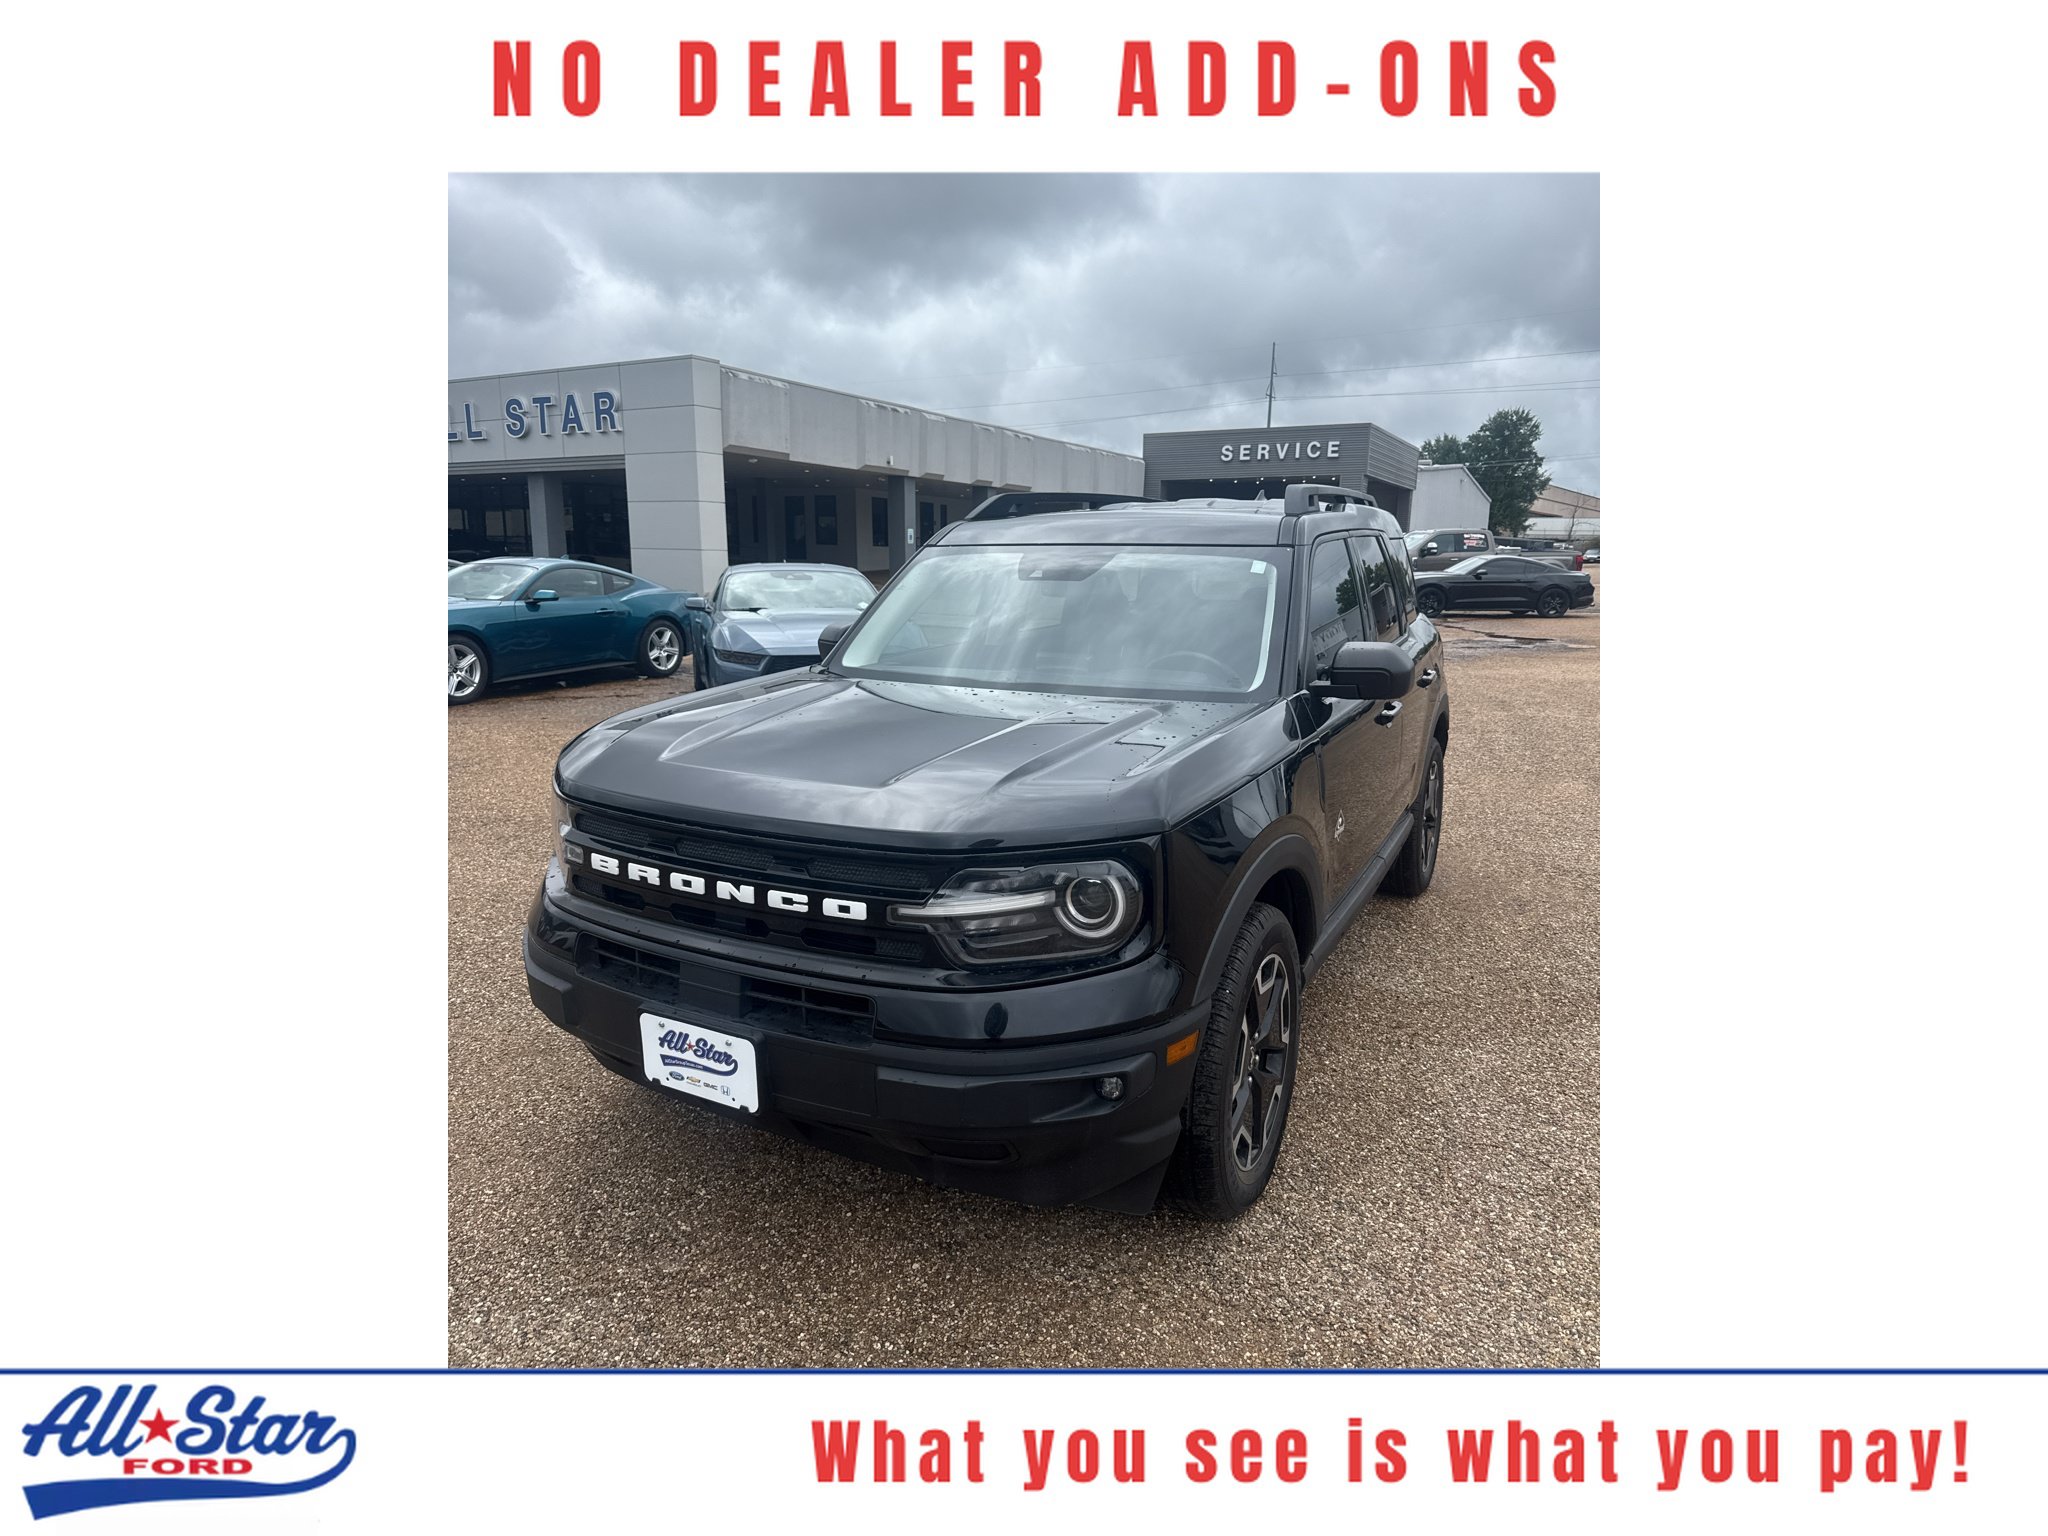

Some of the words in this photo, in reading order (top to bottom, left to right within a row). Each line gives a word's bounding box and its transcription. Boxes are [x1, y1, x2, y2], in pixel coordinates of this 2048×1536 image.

[504, 390, 623, 439] STAR
[1220, 441, 1340, 462] SERVICE
[590, 852, 868, 921] BRONCO
[658, 1029, 689, 1054] All
[693, 1037, 733, 1067] Star
[703, 1082, 719, 1091] GMC
